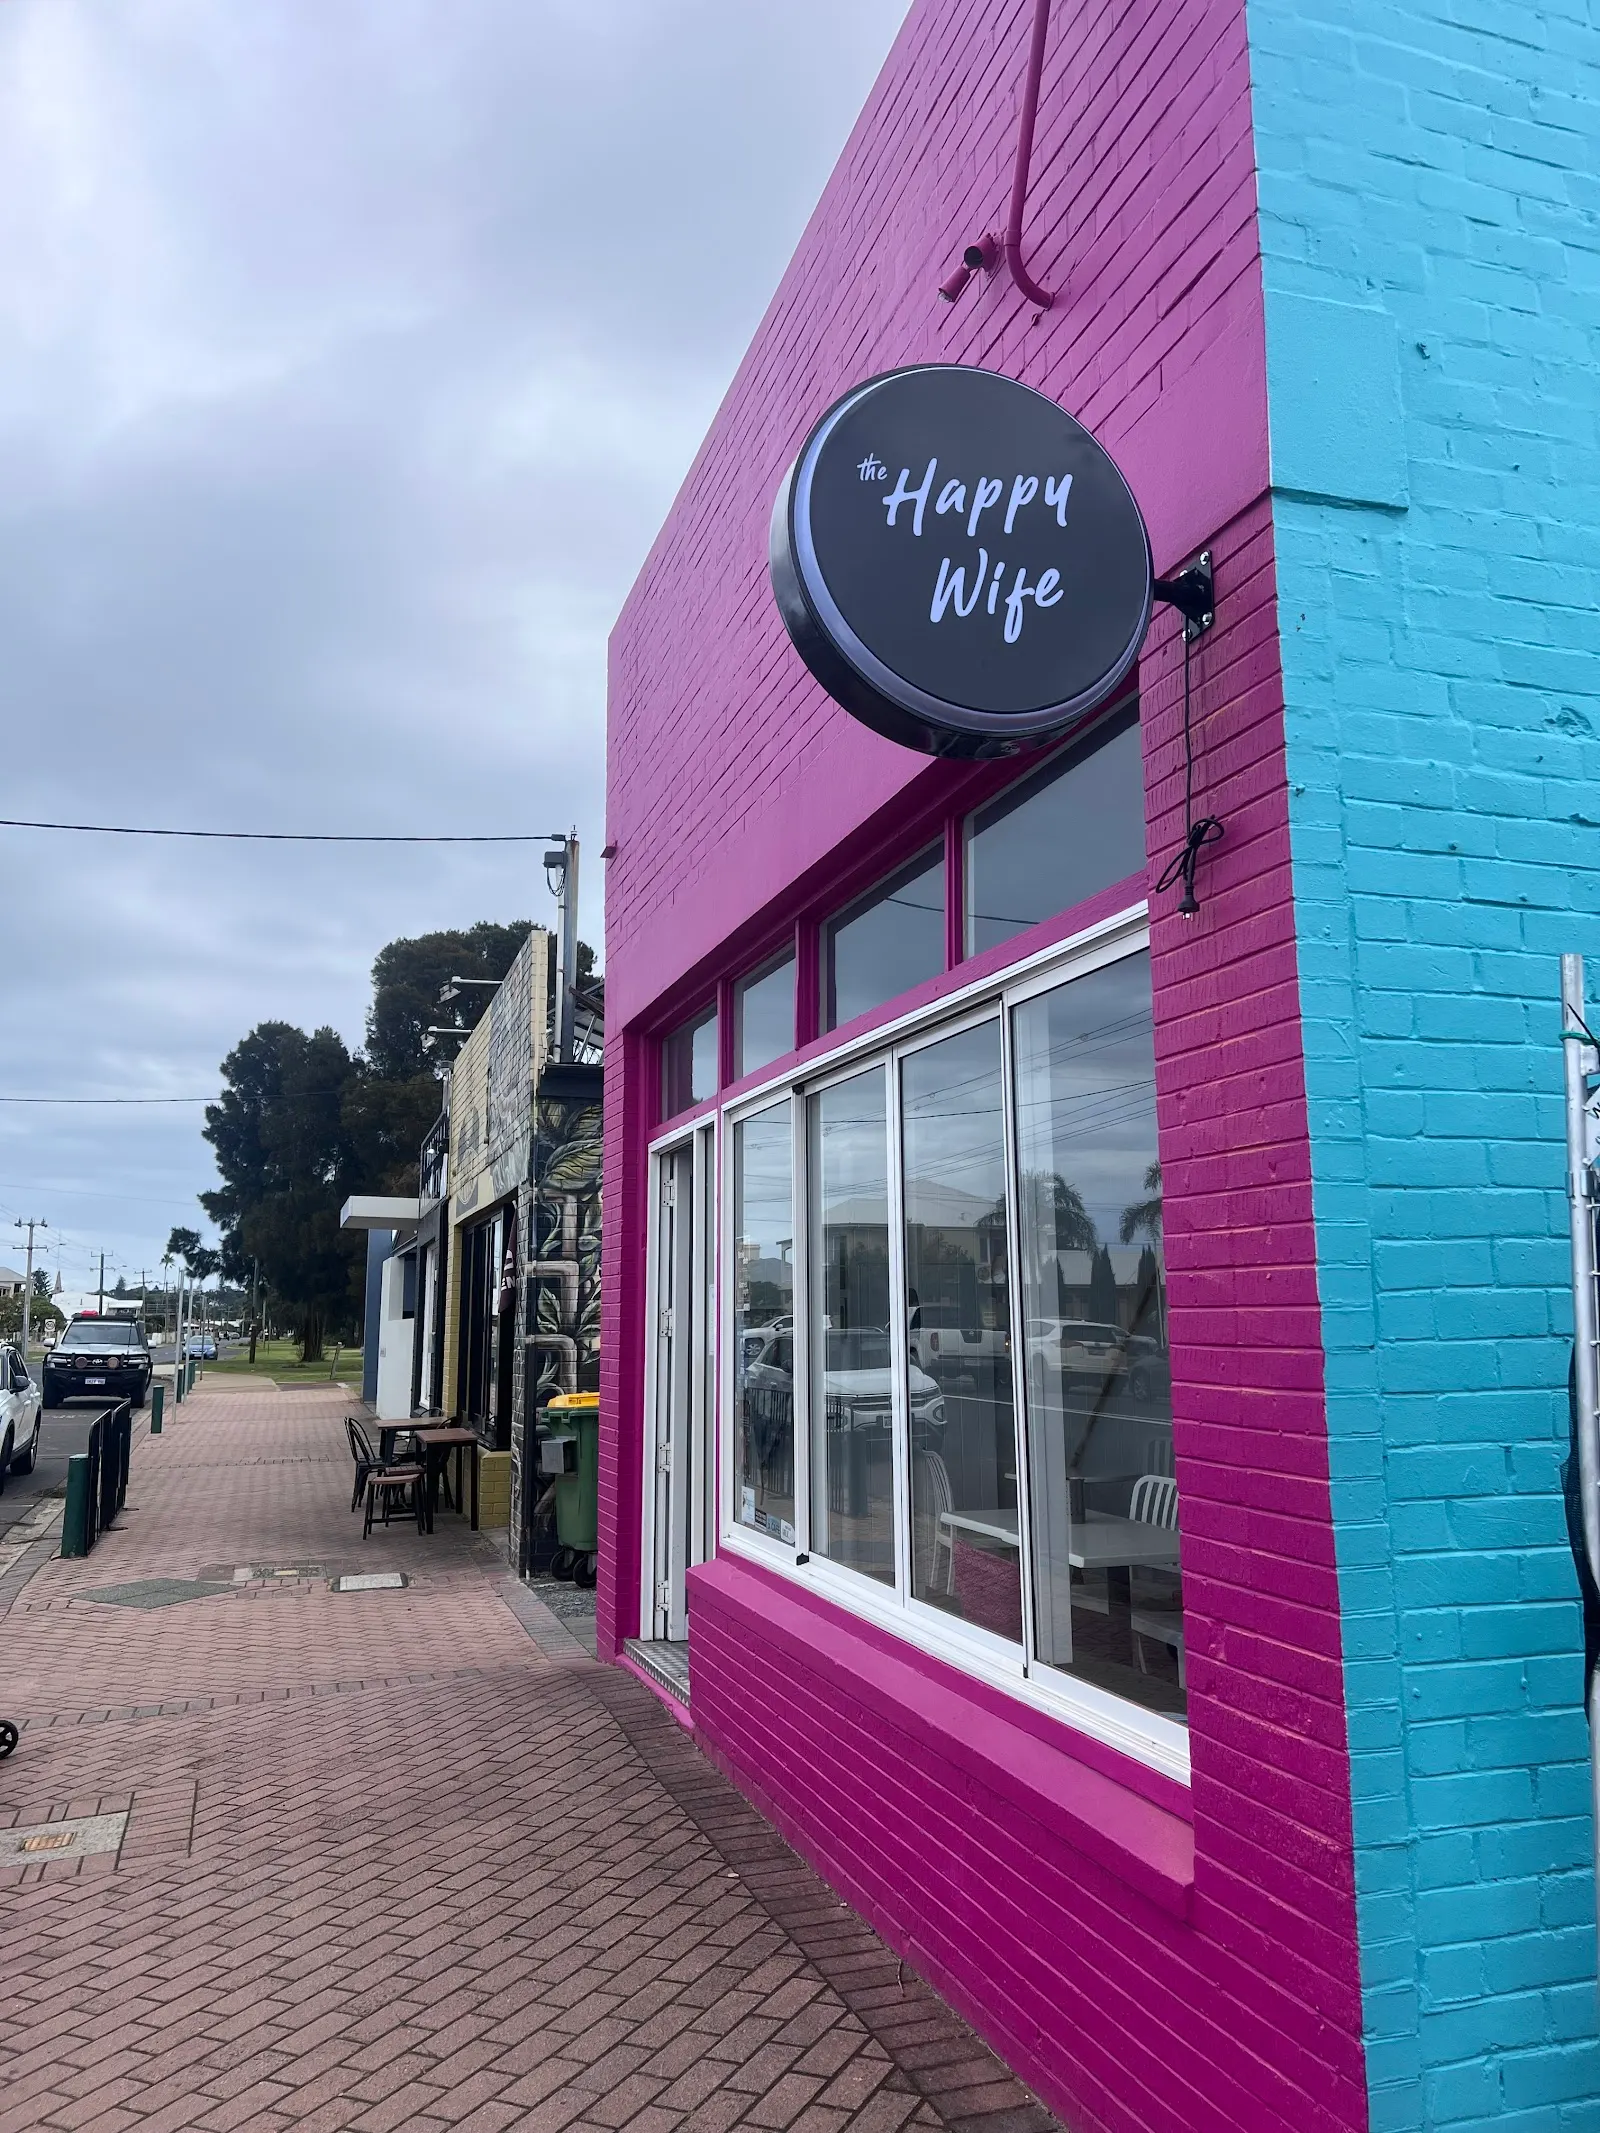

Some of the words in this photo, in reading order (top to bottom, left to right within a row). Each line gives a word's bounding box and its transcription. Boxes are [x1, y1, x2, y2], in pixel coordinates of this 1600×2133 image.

[857, 452, 888, 482] the
[882, 457, 1074, 537] Happy
[929, 547, 1065, 644] Wife
